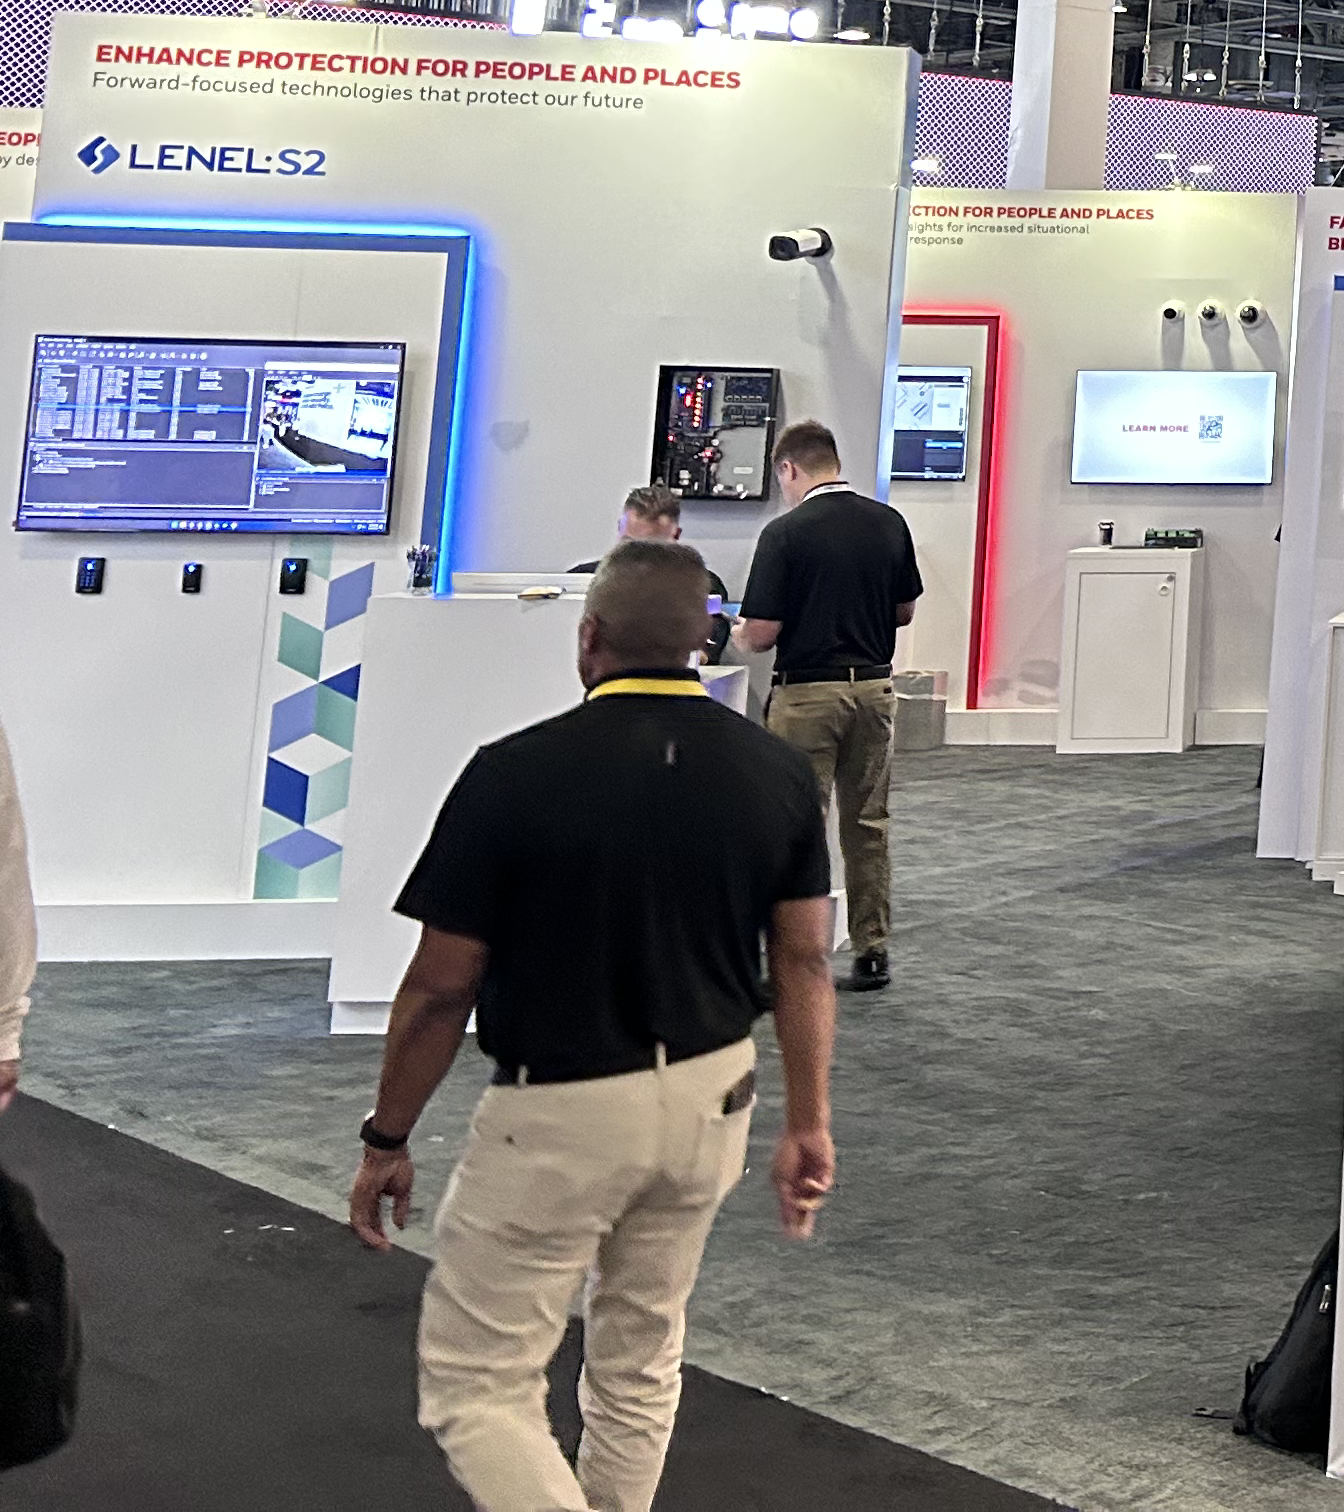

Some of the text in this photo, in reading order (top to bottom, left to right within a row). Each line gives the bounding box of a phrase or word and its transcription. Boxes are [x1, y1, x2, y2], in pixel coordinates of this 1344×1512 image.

[95, 44, 741, 89] ENHANCE PROTECTION FOR PEOPLE AND PLACES
[92, 71, 644, 109] Forward-focused technologies that protect our future
[908, 205, 1155, 220] CTION FOR PEOPLE AND PLACES
[947, 222, 964, 232] for
[967, 223, 1024, 234] increased
[1027, 224, 1089, 235] situational
[909, 236, 963, 246] response
[1122, 424, 1189, 433] LEARN MORE
